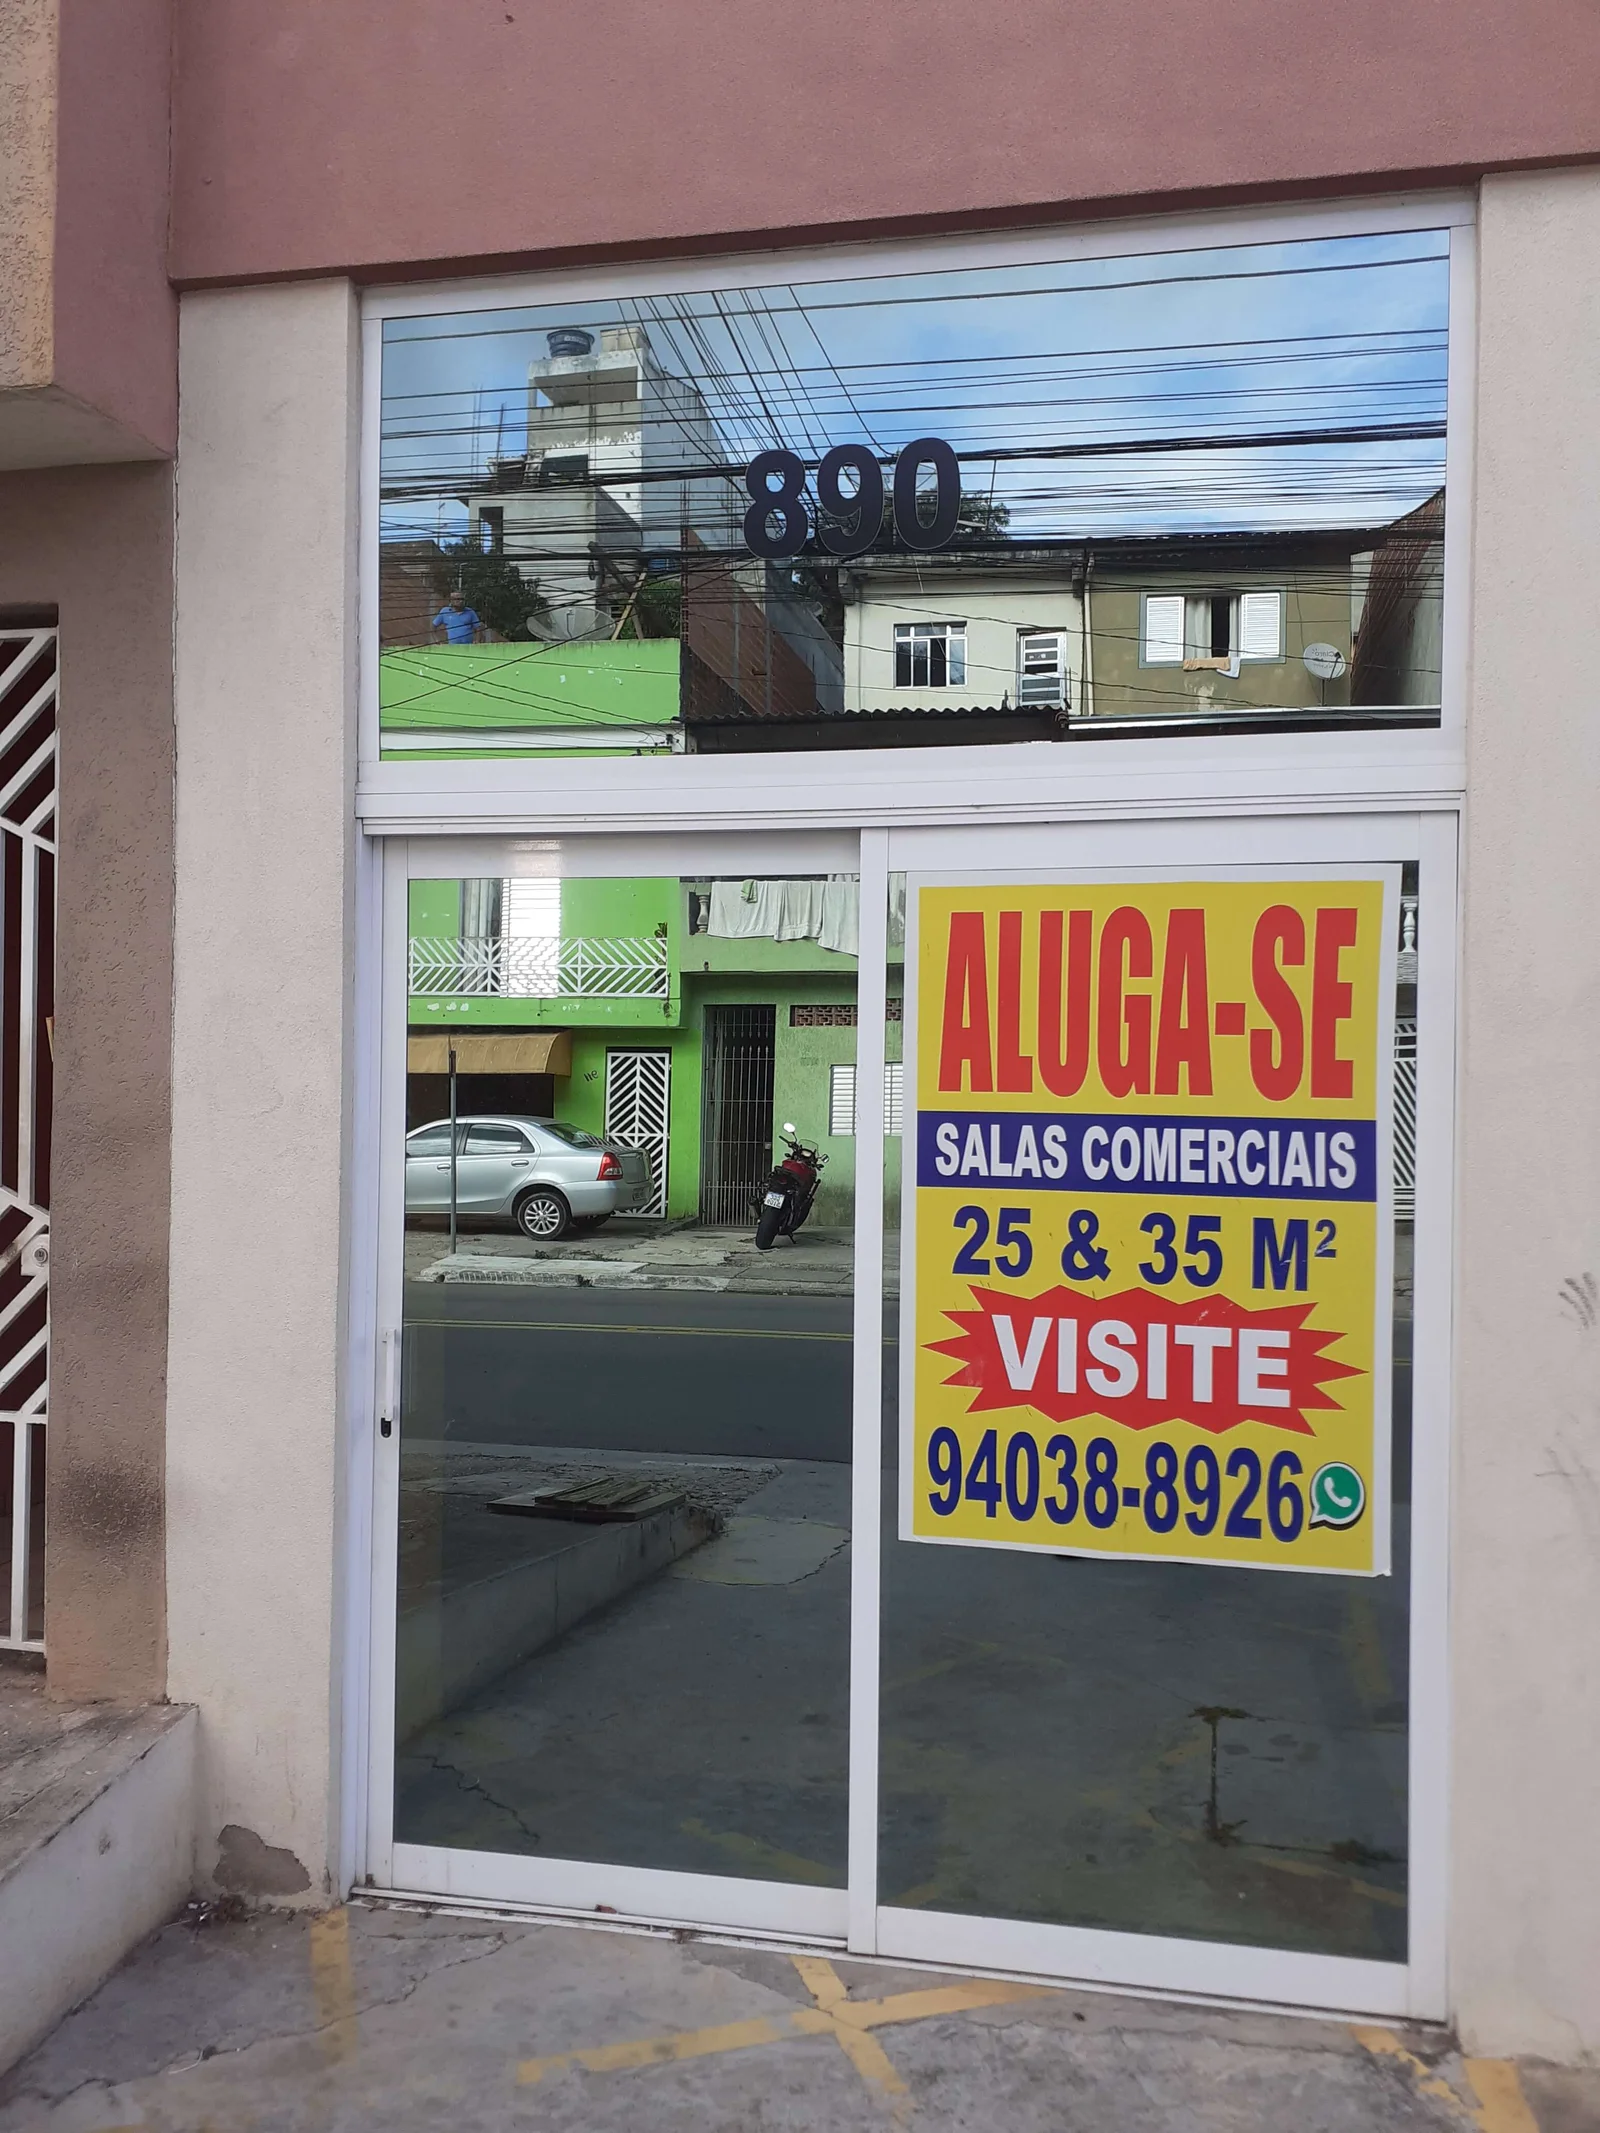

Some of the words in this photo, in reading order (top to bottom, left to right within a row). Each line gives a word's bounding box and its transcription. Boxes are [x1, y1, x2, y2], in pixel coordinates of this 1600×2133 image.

[743, 437, 961, 559] 890
[937, 904, 1358, 1102] ALUGA-SE
[935, 1121, 1068, 1179] SALAS
[1081, 1125, 1358, 1189] COMERCIAIS
[951, 1204, 1033, 1278] 25
[1060, 1208, 1111, 1282] &
[1137, 1211, 1223, 1288] 35
[991, 1314, 1291, 1408] VISITE
[926, 1426, 1304, 1543] 94038-8926
